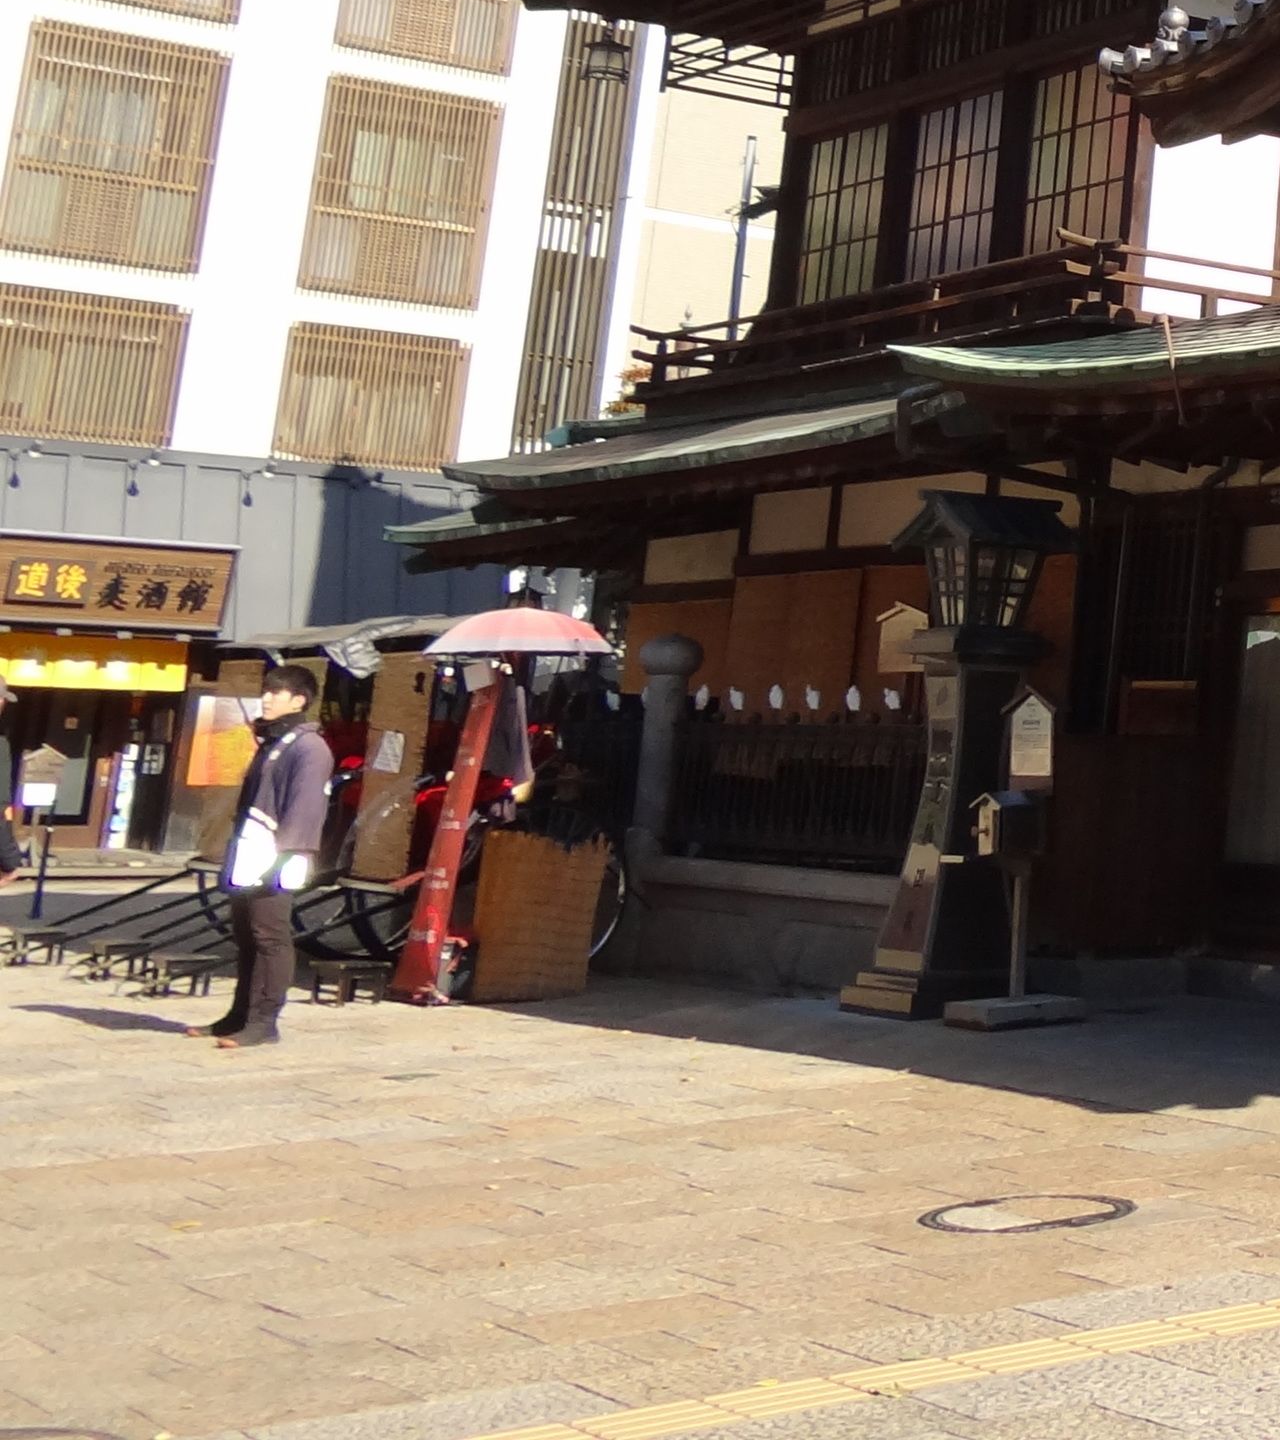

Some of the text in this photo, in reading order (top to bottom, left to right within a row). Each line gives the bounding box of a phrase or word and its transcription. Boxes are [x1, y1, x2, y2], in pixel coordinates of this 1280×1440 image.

[15, 561, 88, 599] 道後
[96, 572, 214, 614] 麦酒館
